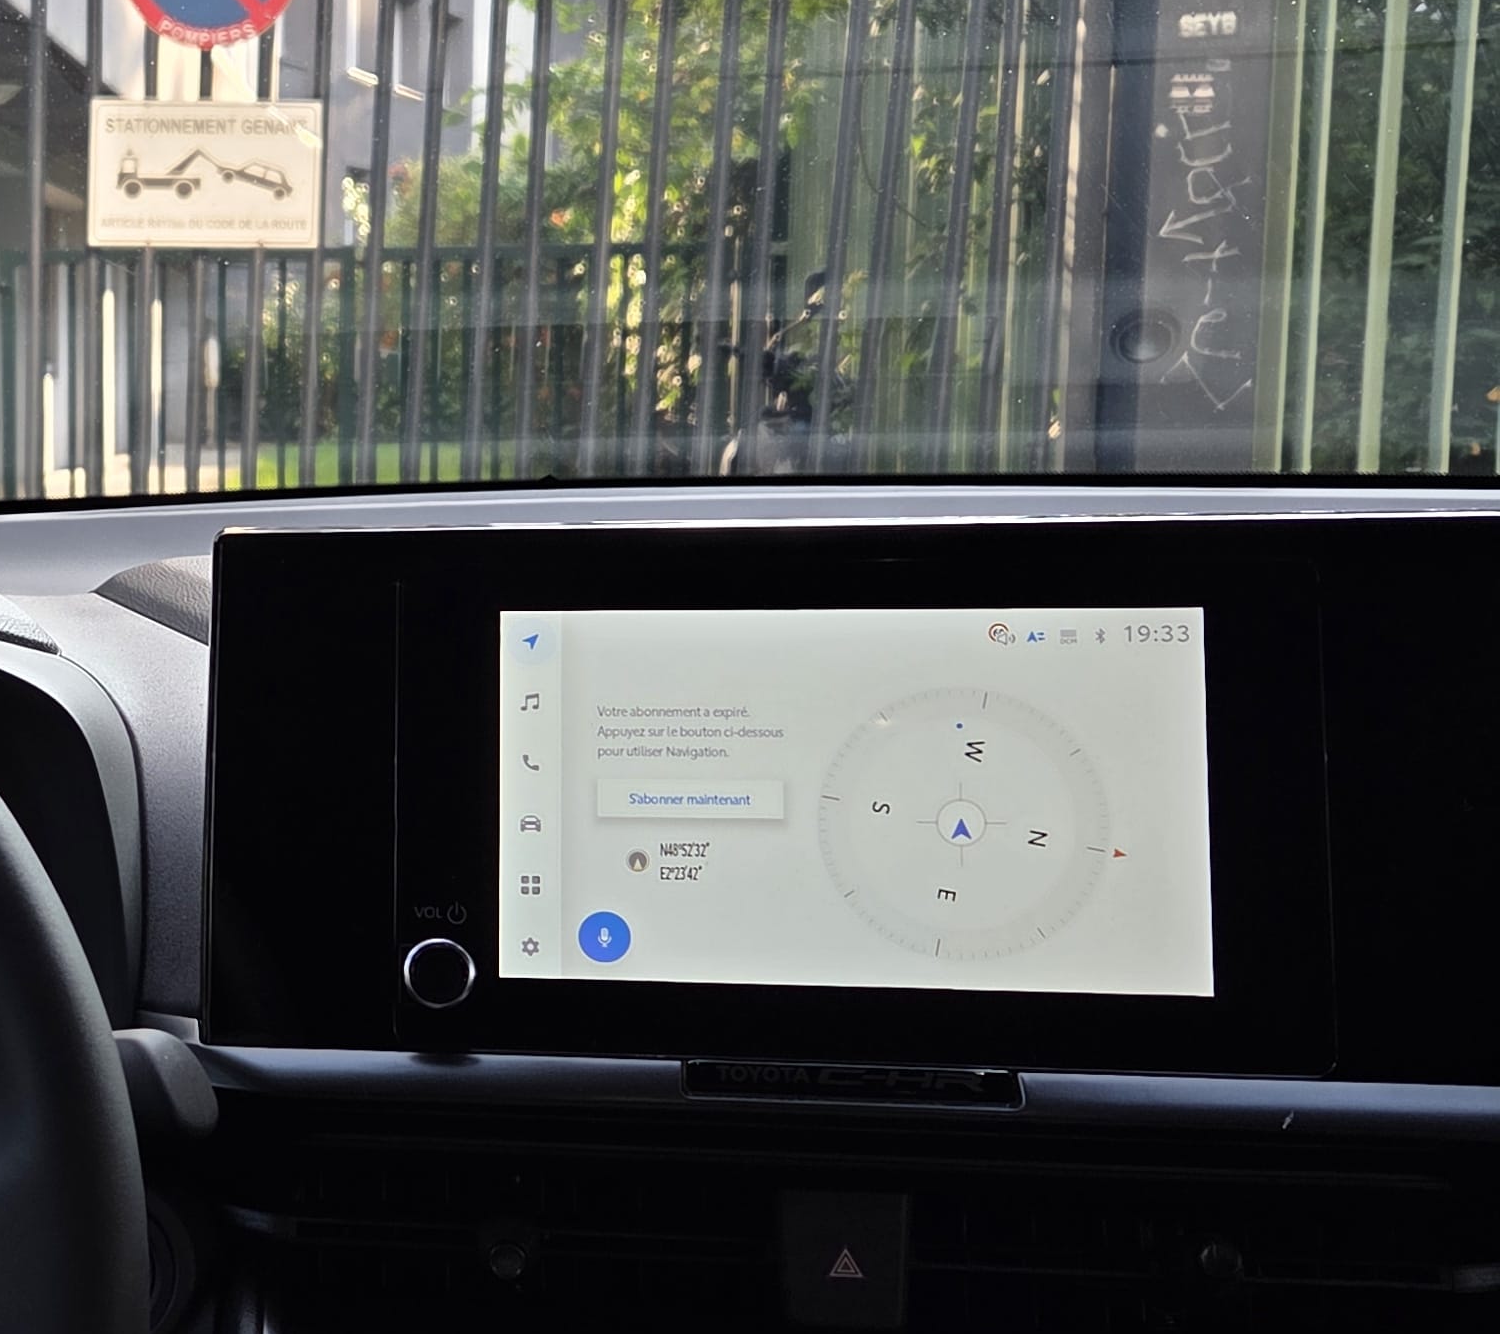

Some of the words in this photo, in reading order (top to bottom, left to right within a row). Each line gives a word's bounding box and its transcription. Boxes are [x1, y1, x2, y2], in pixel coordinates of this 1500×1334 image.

[160, 19, 256, 44] POMPIERS
[105, 118, 237, 135] STATIONNEMENT
[1124, 624, 1190, 643] 19:33
[597, 706, 628, 717] Votre
[629, 706, 700, 717] abonnement
[597, 725, 645, 739] Appuyez
[647, 729, 664, 738] sur
[667, 726, 678, 738] le
[680, 726, 722, 738] bouton
[724, 726, 784, 738] ci-dessous
[597, 747, 624, 759] pour
[626, 746, 663, 757] utiliser
[964, 741, 986, 762] W
[687, 793, 751, 806] maintenant
[872, 801, 891, 814] S
[1027, 830, 1048, 847] N
[937, 888, 956, 902] E
[716, 1065, 811, 1084] TOYOTA
